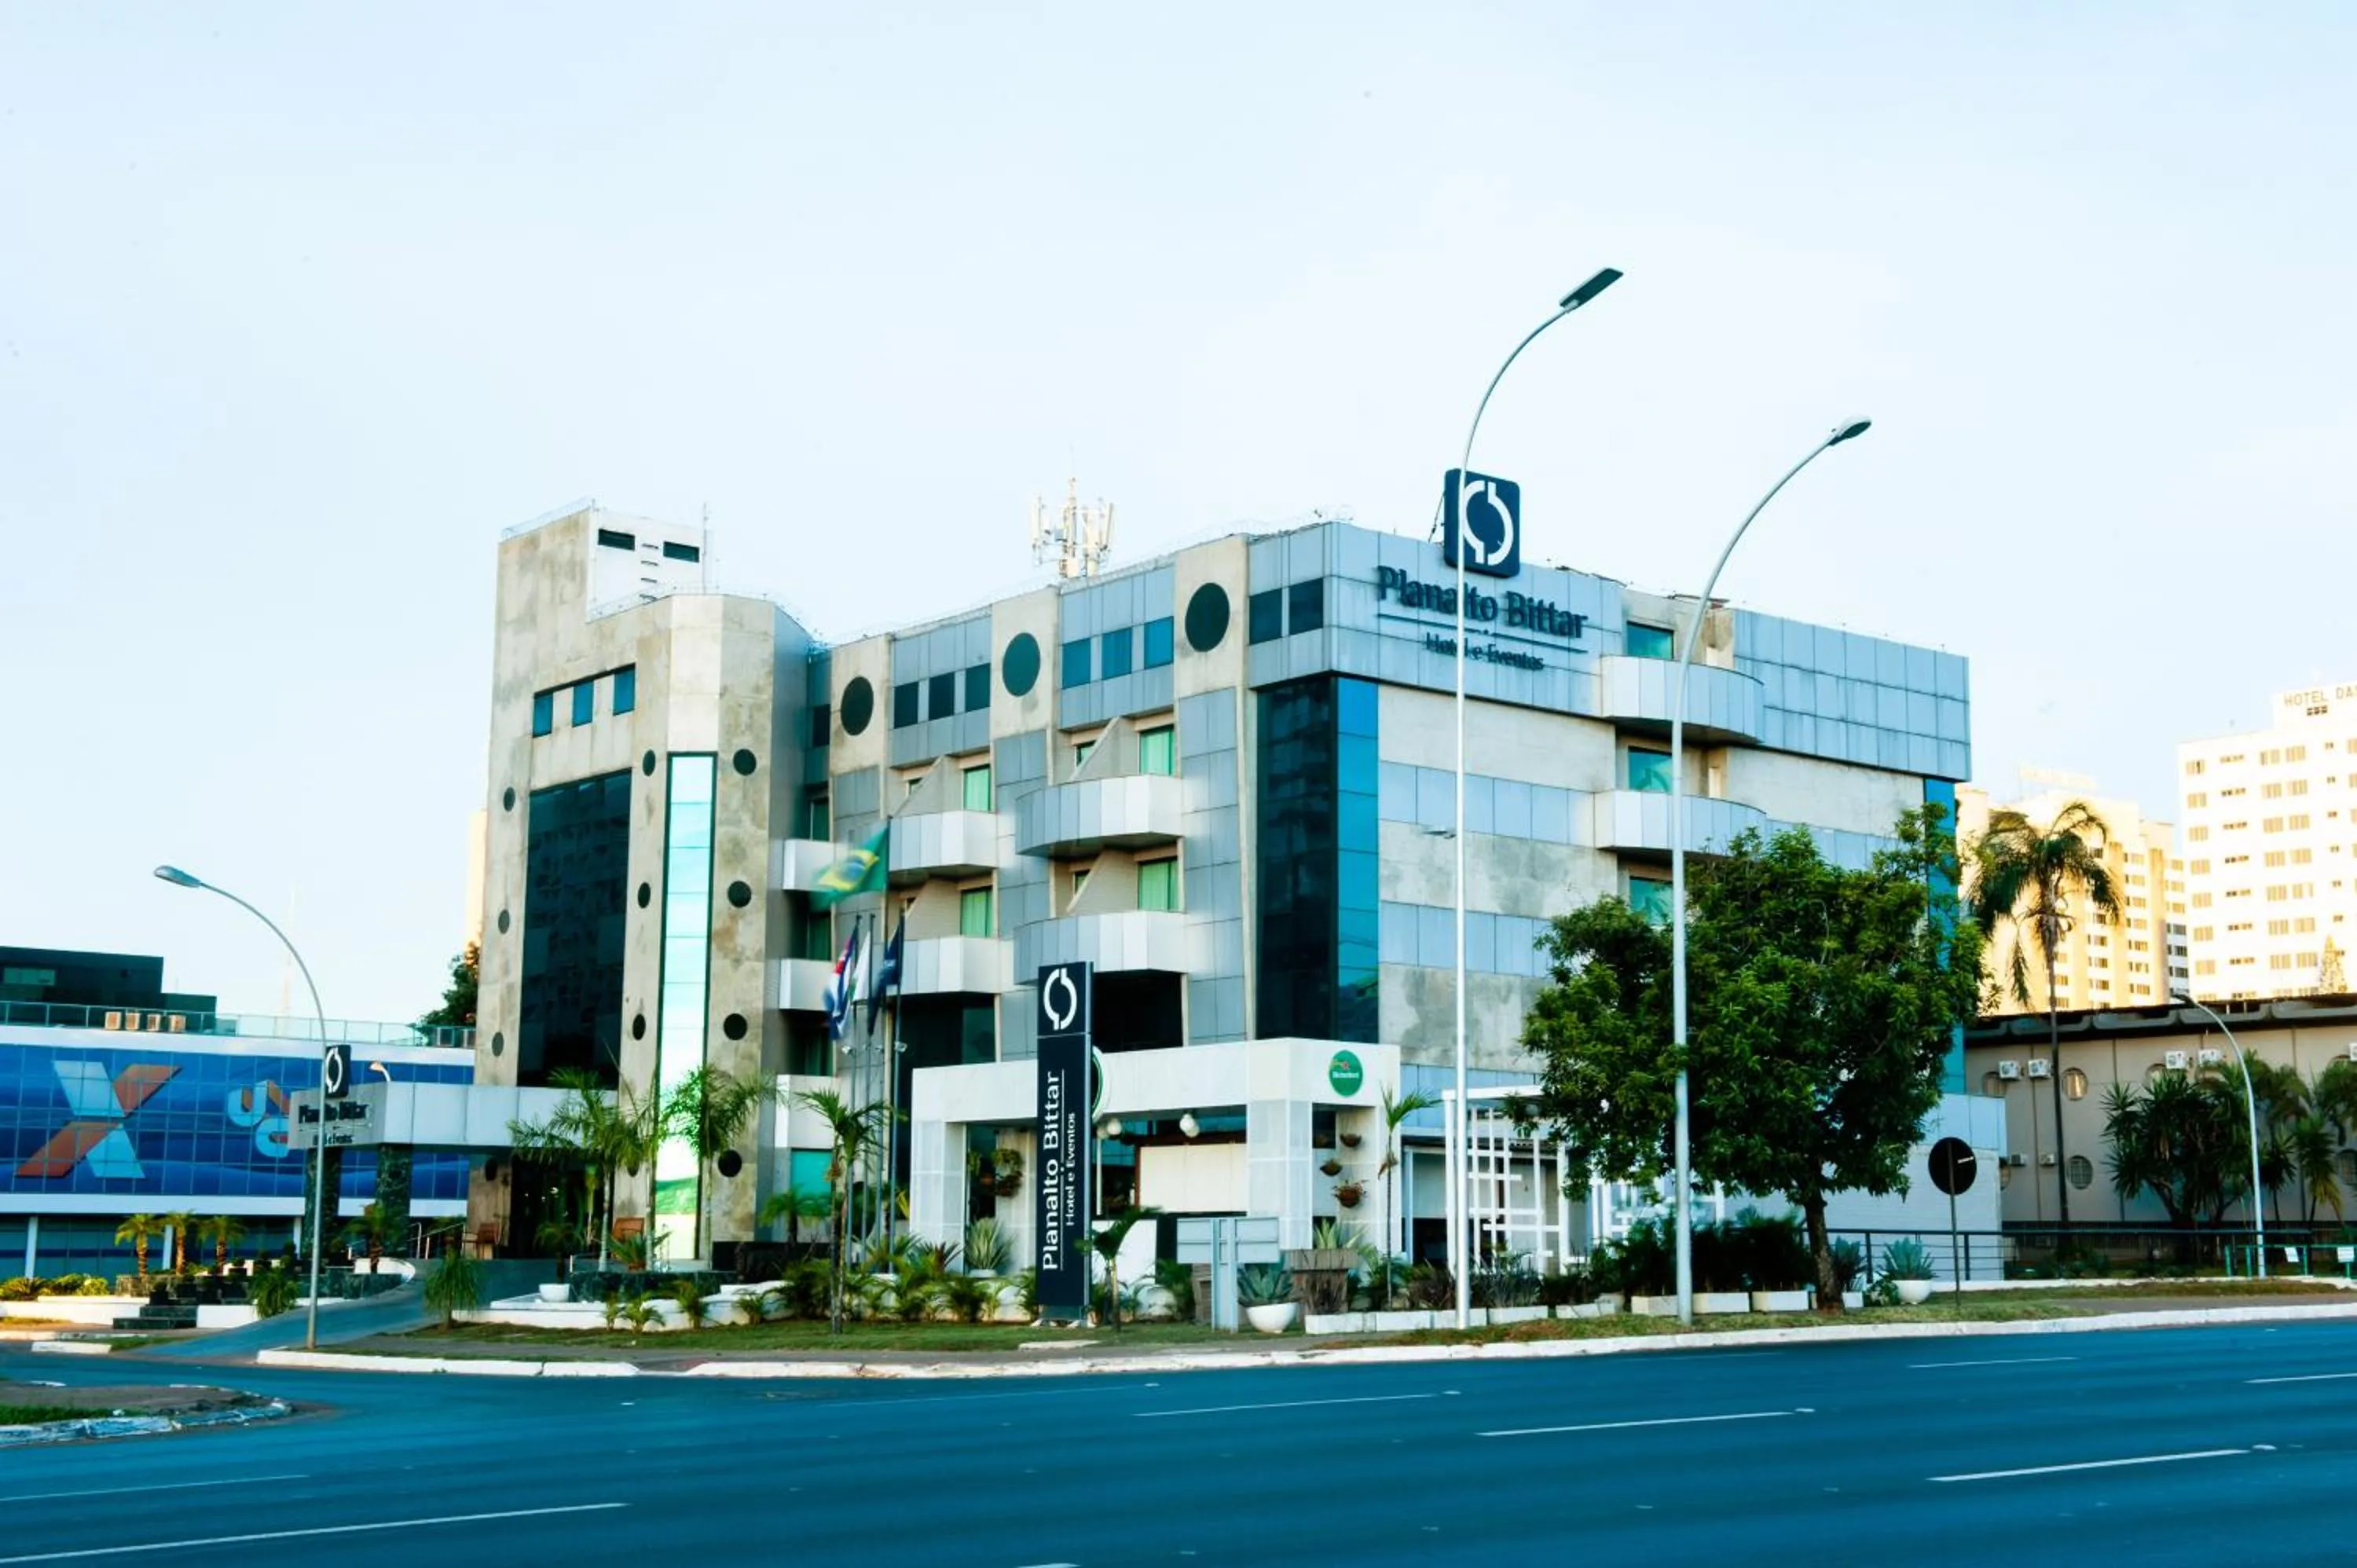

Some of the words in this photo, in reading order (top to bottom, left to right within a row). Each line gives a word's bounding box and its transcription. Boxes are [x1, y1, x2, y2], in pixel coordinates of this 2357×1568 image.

[1376, 565, 1499, 622] Planalto
[1506, 590, 1589, 639] Bittar
[2284, 689, 2330, 707] HOTEL
[2336, 683, 2357, 700] DA
[1043, 1071, 1060, 1150] Bittar
[1065, 1112, 1076, 1168] Eventos
[1068, 1171, 1076, 1182] e
[1042, 1159, 1058, 1270] Planalto
[1065, 1185, 1076, 1226] Hotel
